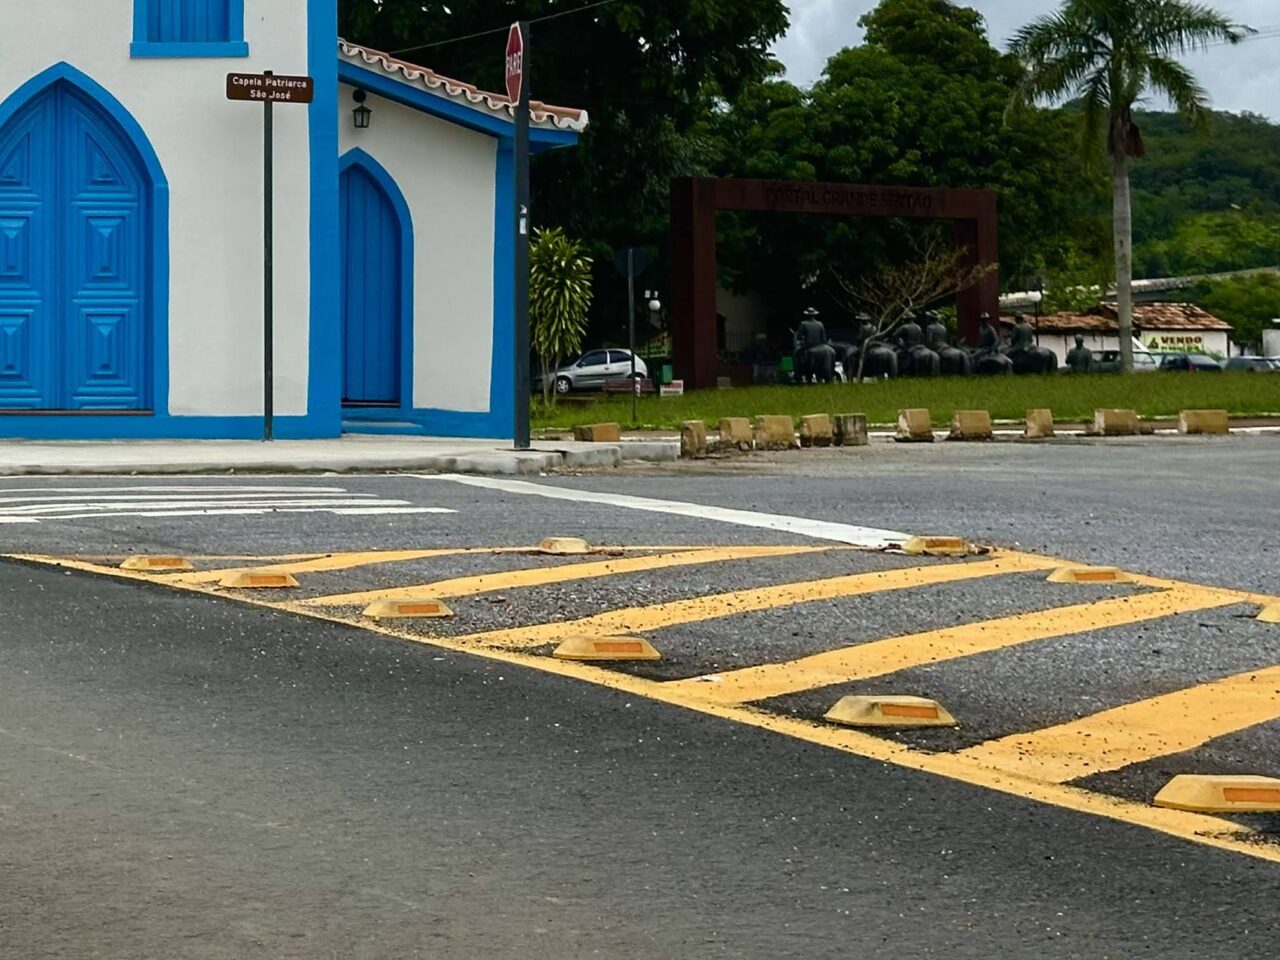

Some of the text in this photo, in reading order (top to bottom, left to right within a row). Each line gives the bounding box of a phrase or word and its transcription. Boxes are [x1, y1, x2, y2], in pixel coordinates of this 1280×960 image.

[506, 51, 521, 77] PARE
[232, 76, 307, 88] Capela Patriarca
[250, 89, 291, 100] São José
[1160, 336, 1202, 344] VENDO
